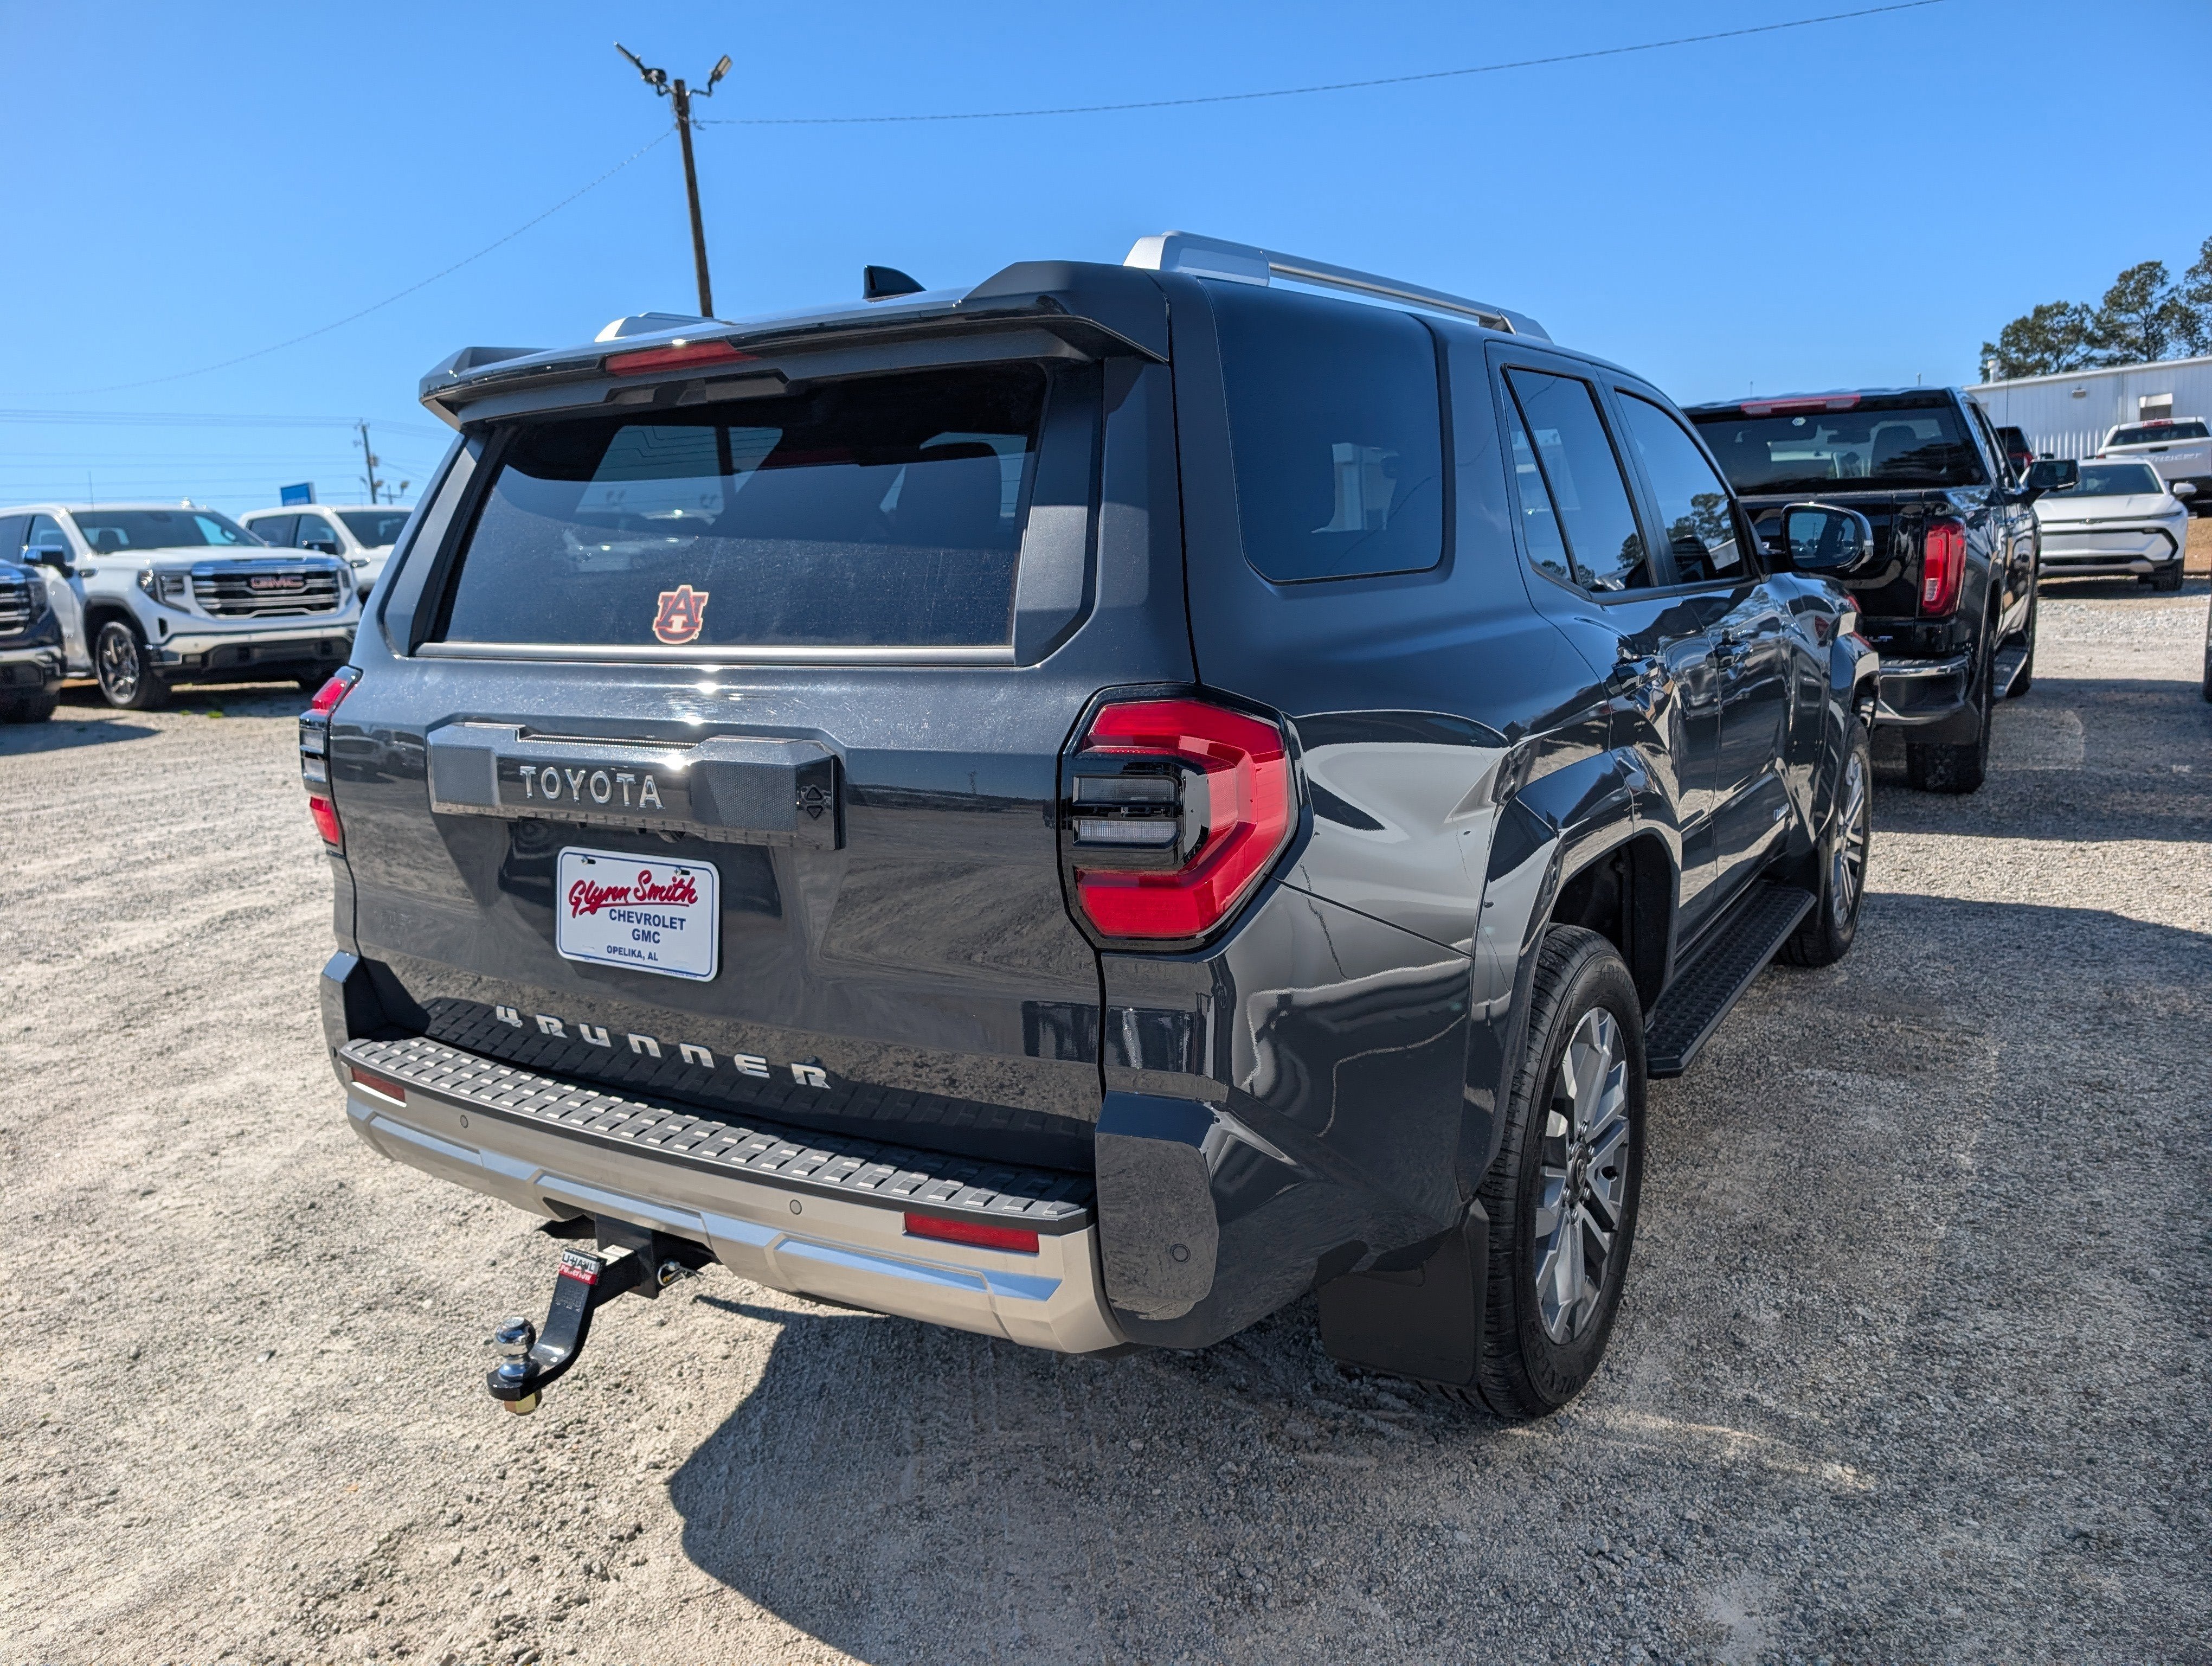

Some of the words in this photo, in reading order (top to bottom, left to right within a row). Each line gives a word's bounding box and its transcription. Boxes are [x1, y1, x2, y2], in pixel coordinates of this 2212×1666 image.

[250, 575, 304, 589] GMC
[519, 765, 665, 810] TOYOTA
[568, 879, 631, 918] Glynn
[633, 869, 698, 904] Smith
[609, 908, 686, 931] CHEVROLET
[632, 928, 661, 944] GMC
[607, 945, 645, 961] OPELIKA,
[647, 951, 658, 962] AL
[562, 1253, 594, 1272] U-HAUL
